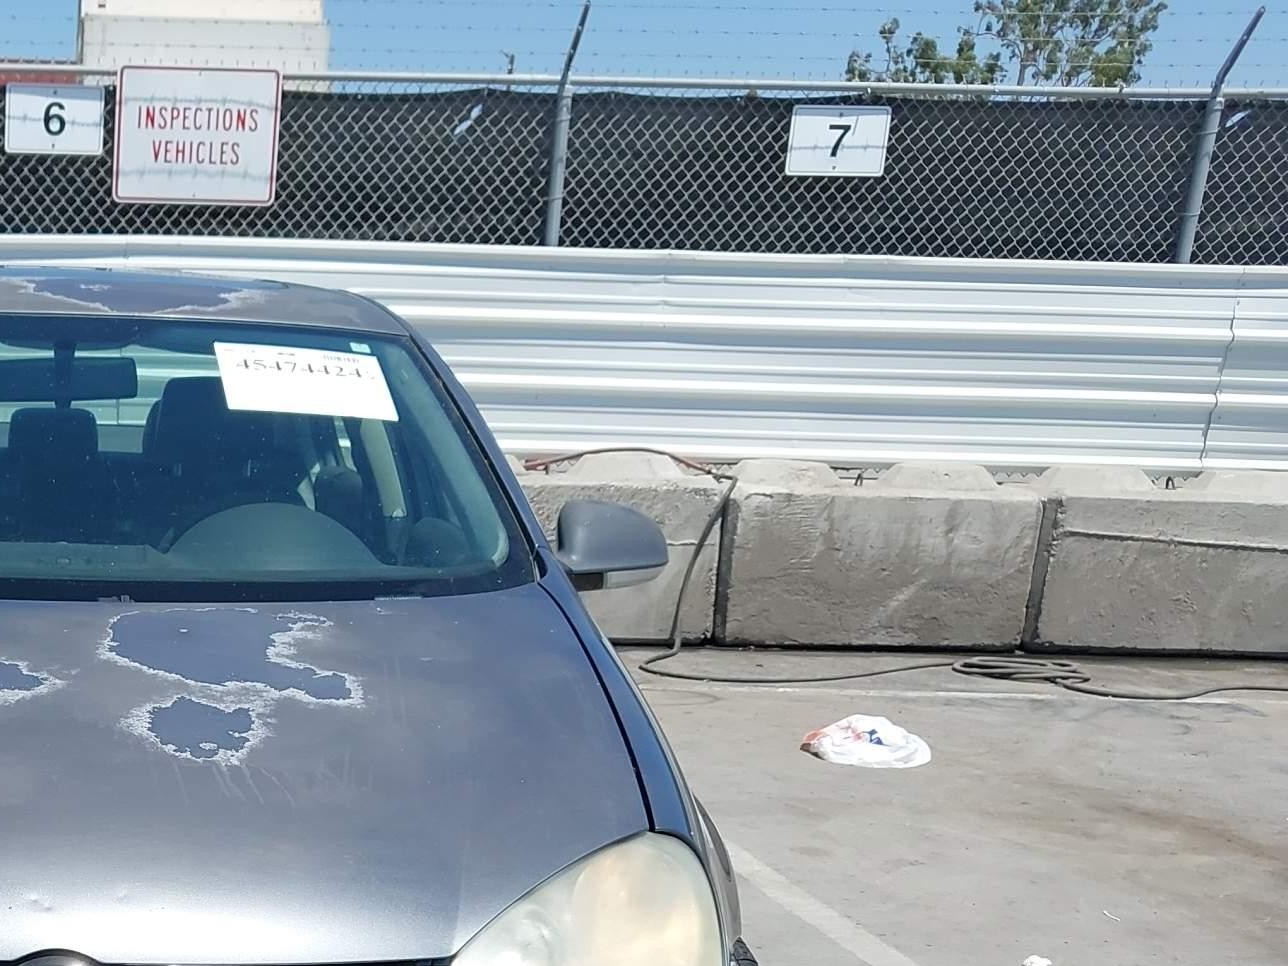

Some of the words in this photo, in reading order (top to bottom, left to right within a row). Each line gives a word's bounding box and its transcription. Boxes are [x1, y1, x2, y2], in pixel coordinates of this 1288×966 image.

[43, 102, 66, 136] 6
[137, 105, 259, 132] INSPECTIONS
[152, 140, 240, 165] VEHICLES
[829, 124, 852, 158] 7
